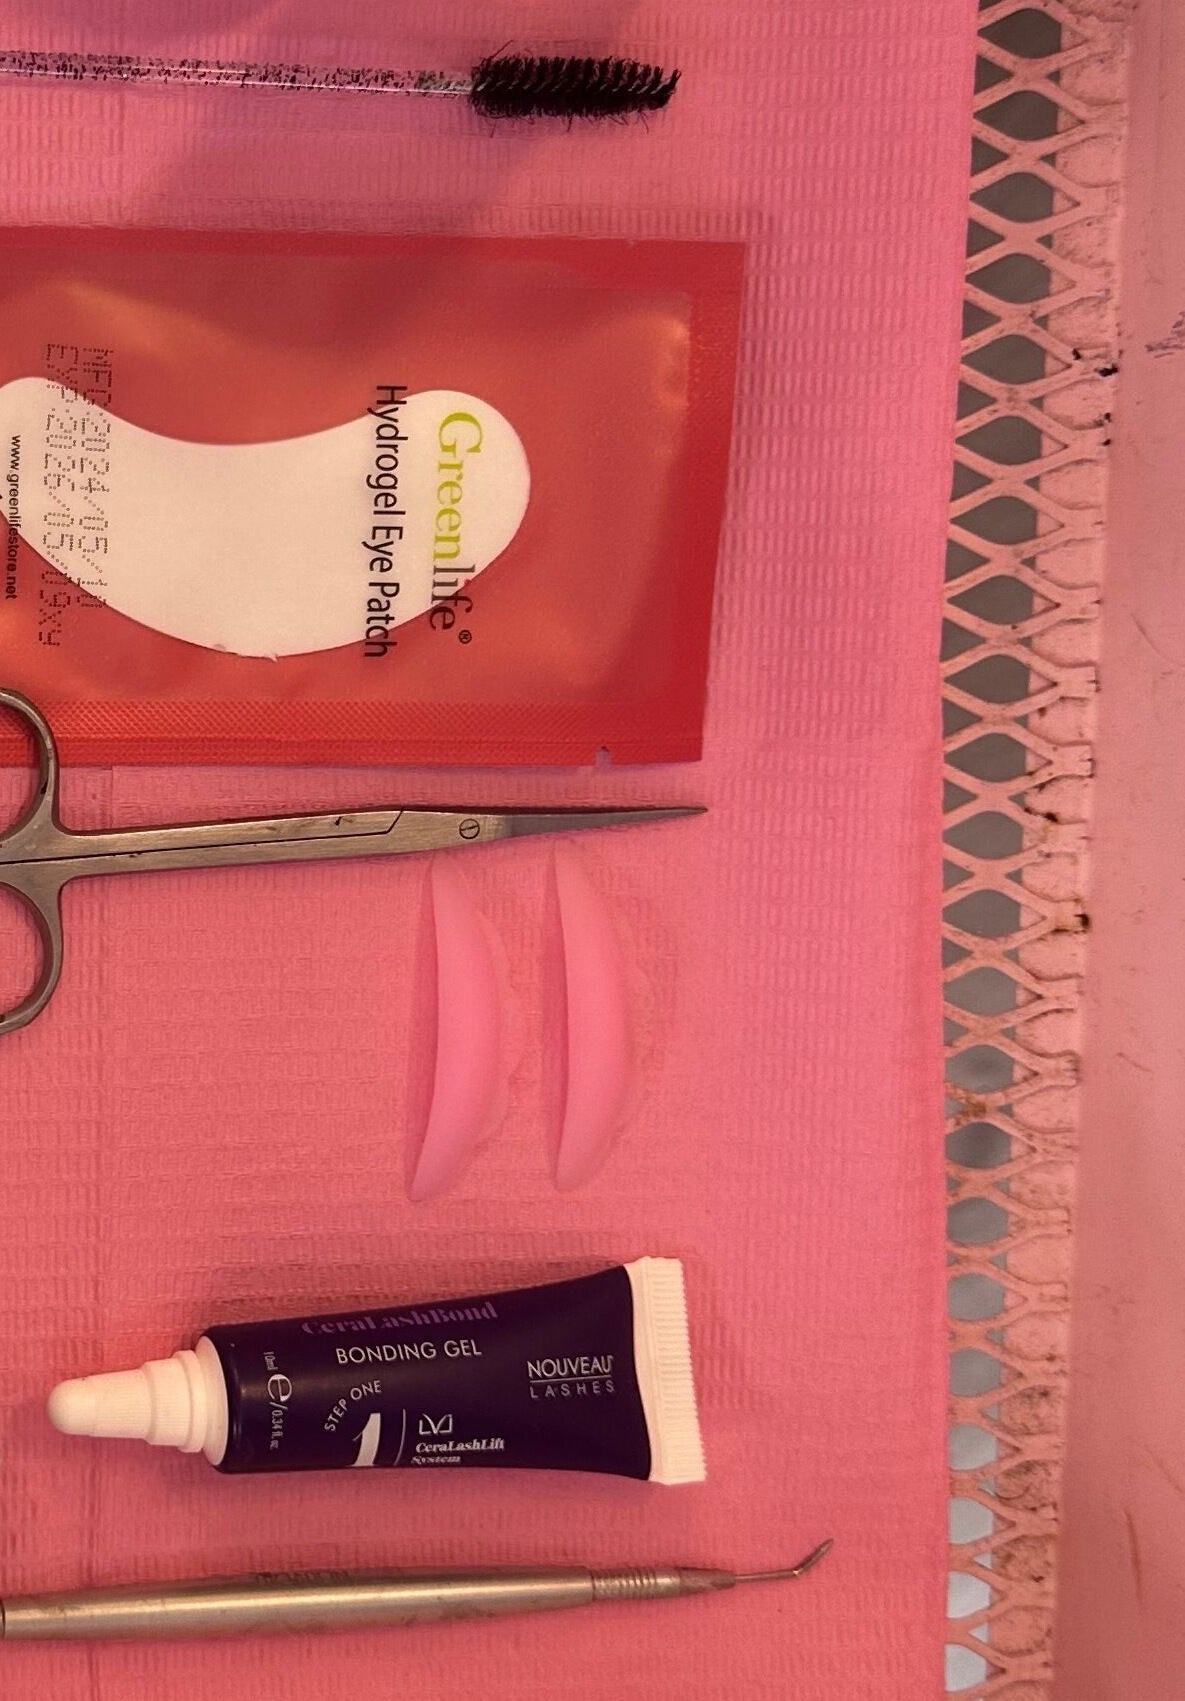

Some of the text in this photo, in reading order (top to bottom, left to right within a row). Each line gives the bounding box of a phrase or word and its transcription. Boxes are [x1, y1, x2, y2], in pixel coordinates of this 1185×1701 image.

[5, 435, 21, 600] www.greenlifestore.net
[362, 385, 409, 657] Hydrogel Eye Patch
[301, 1302, 499, 1335] CeraLashBond
[335, 1338, 483, 1365] BONDING GEL
[527, 1355, 615, 1377] NOUVEAU
[324, 1379, 382, 1432] STEP ONE
[530, 1380, 615, 1399] LASHES
[347, 1412, 382, 1467] 1
[415, 1437, 505, 1453] CeraLashLift
